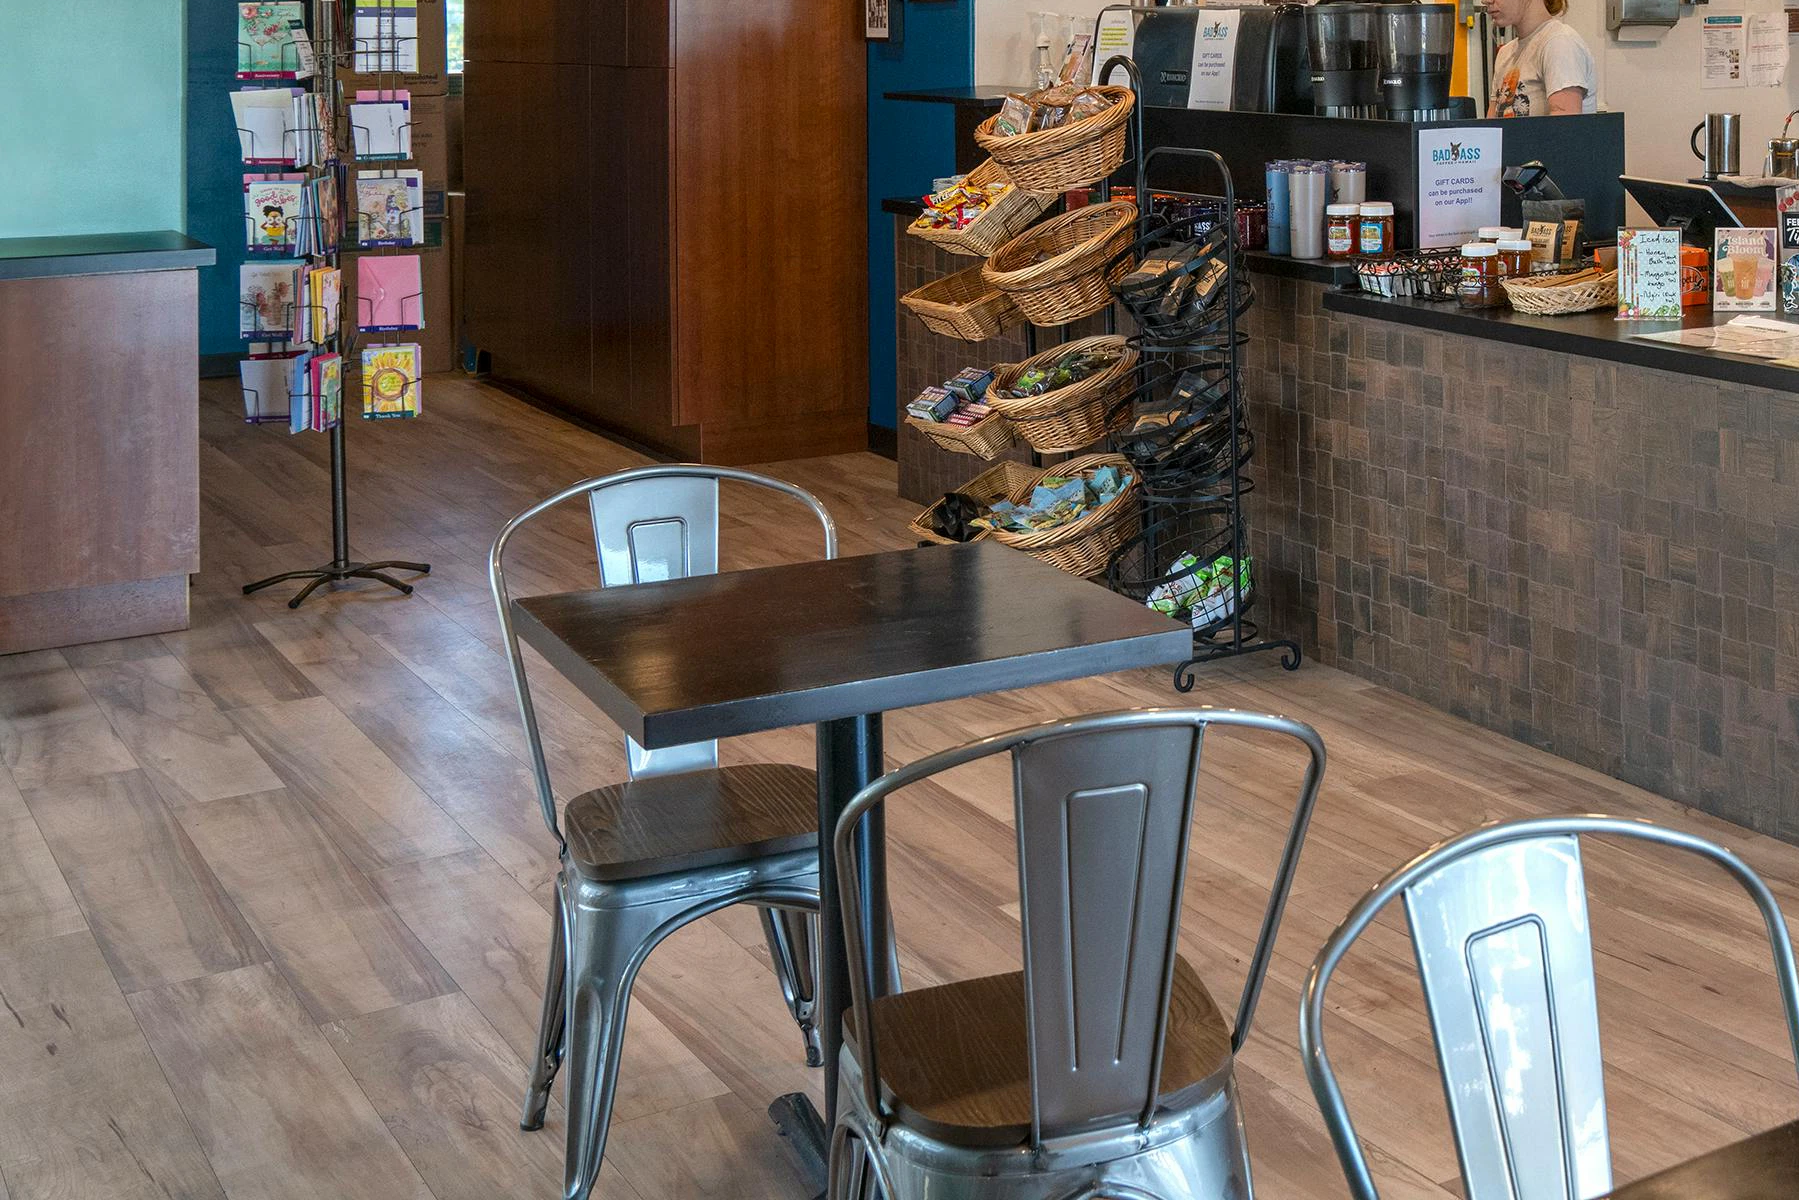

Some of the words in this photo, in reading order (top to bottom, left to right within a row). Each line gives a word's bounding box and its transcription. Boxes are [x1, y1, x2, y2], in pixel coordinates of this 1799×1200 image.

[1433, 149, 1451, 161] BAD
[1460, 148, 1480, 160] ASS
[1451, 177, 1474, 185] CARDS
[1449, 187, 1482, 197] purchased
[1640, 234, 1660, 243] Iced
[1727, 235, 1765, 245] Island
